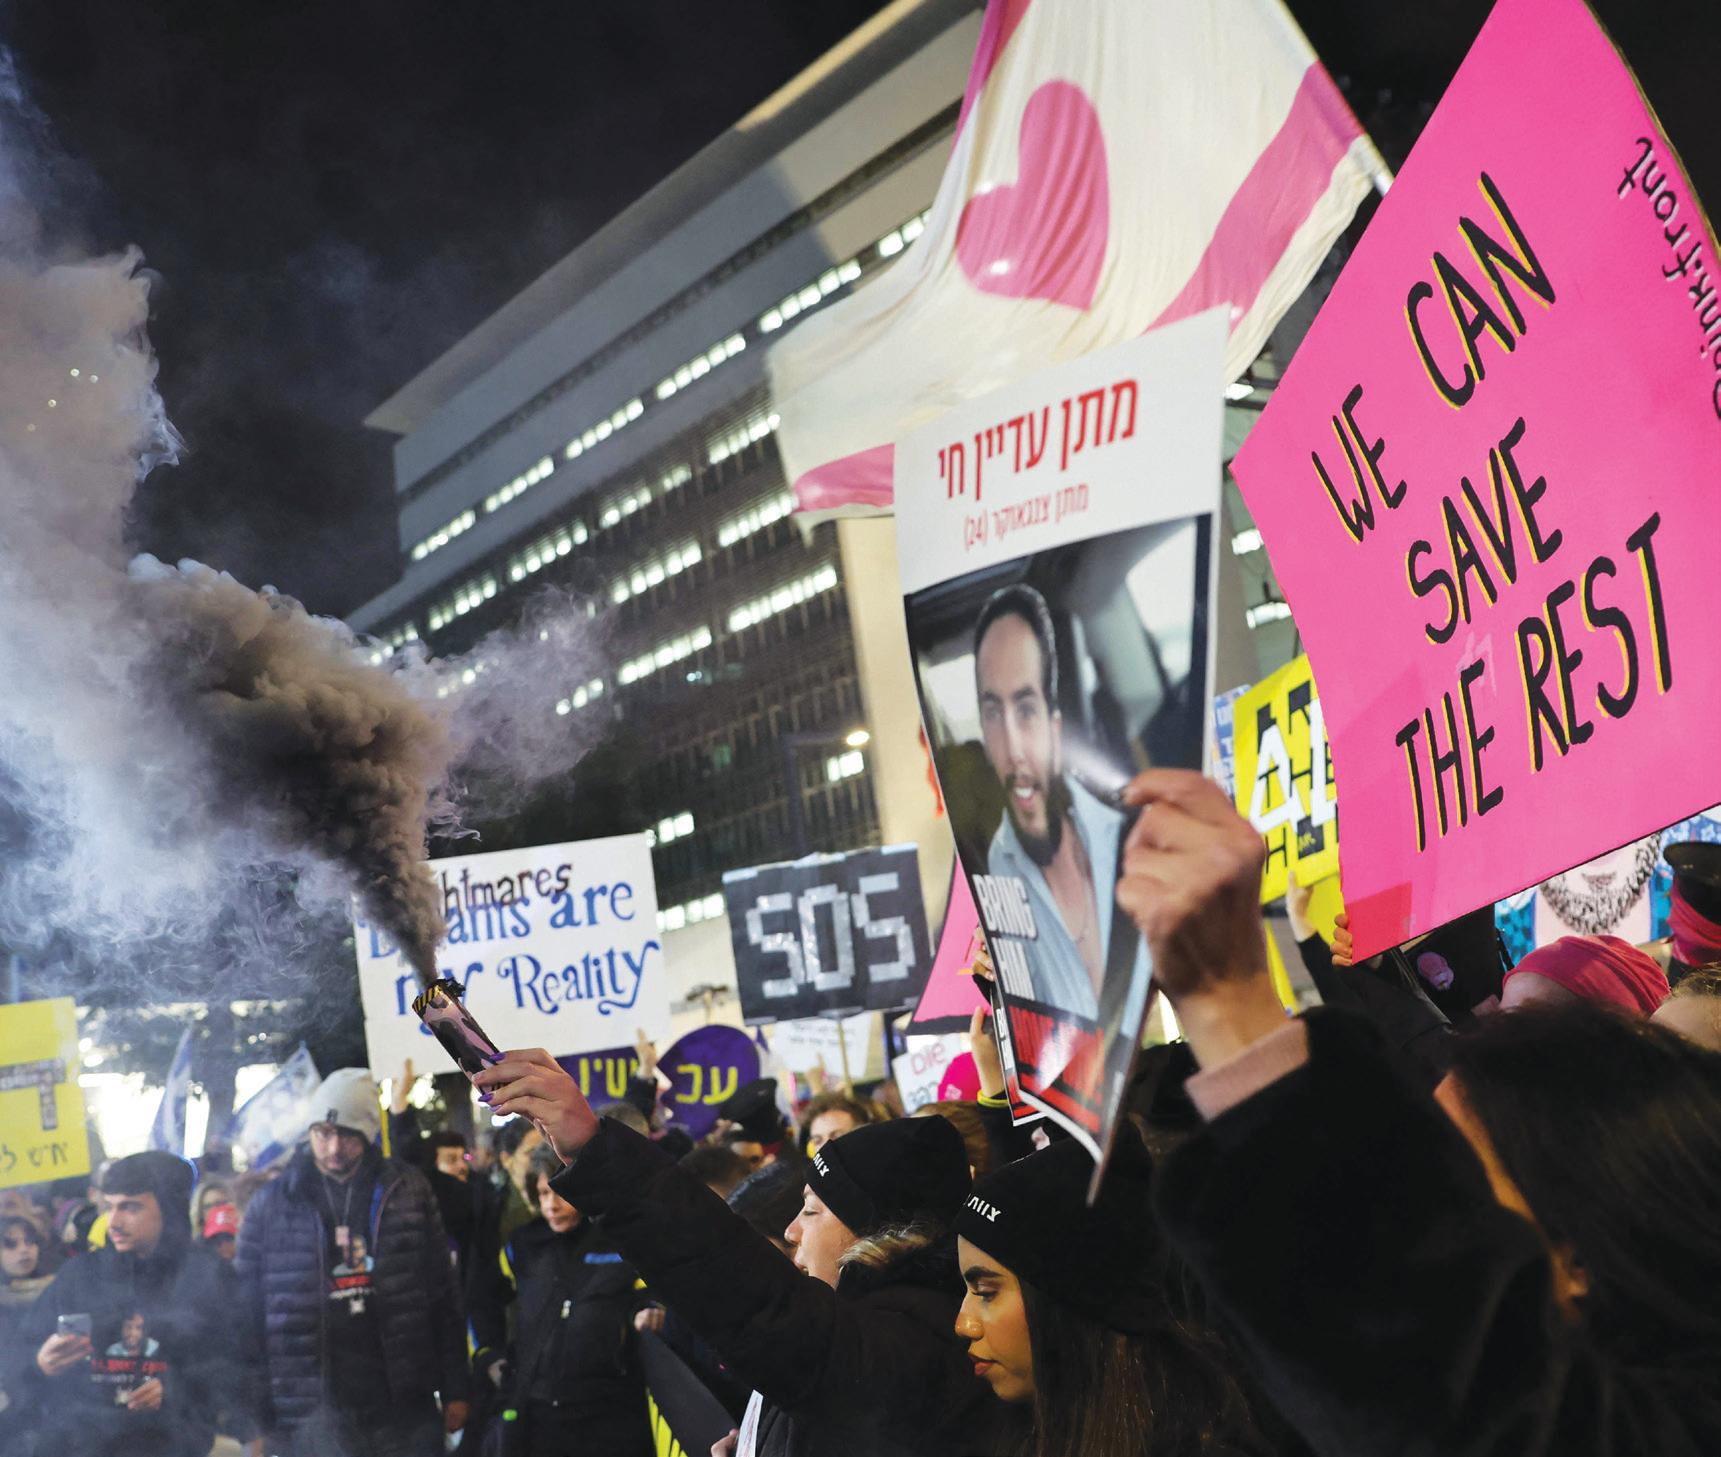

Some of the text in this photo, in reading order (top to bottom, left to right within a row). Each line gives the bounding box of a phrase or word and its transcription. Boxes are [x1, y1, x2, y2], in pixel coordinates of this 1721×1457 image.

[1311, 171, 1557, 544] WE CAN
[938, 378, 1139, 502] מתן עדיין חי
[963, 508, 989, 551] (24)
[1055, 483, 1090, 524] מתן
[1405, 417, 1563, 645] SAVE
[1396, 660, 1504, 853] THE
[1514, 512, 1673, 775] REST
[441, 862, 572, 920] htmares
[549, 880, 636, 931] are
[972, 873, 1037, 940] BRING
[746, 872, 916, 999] 505
[497, 940, 661, 1015] Reality
[966, 1195, 1003, 1223] צוות
